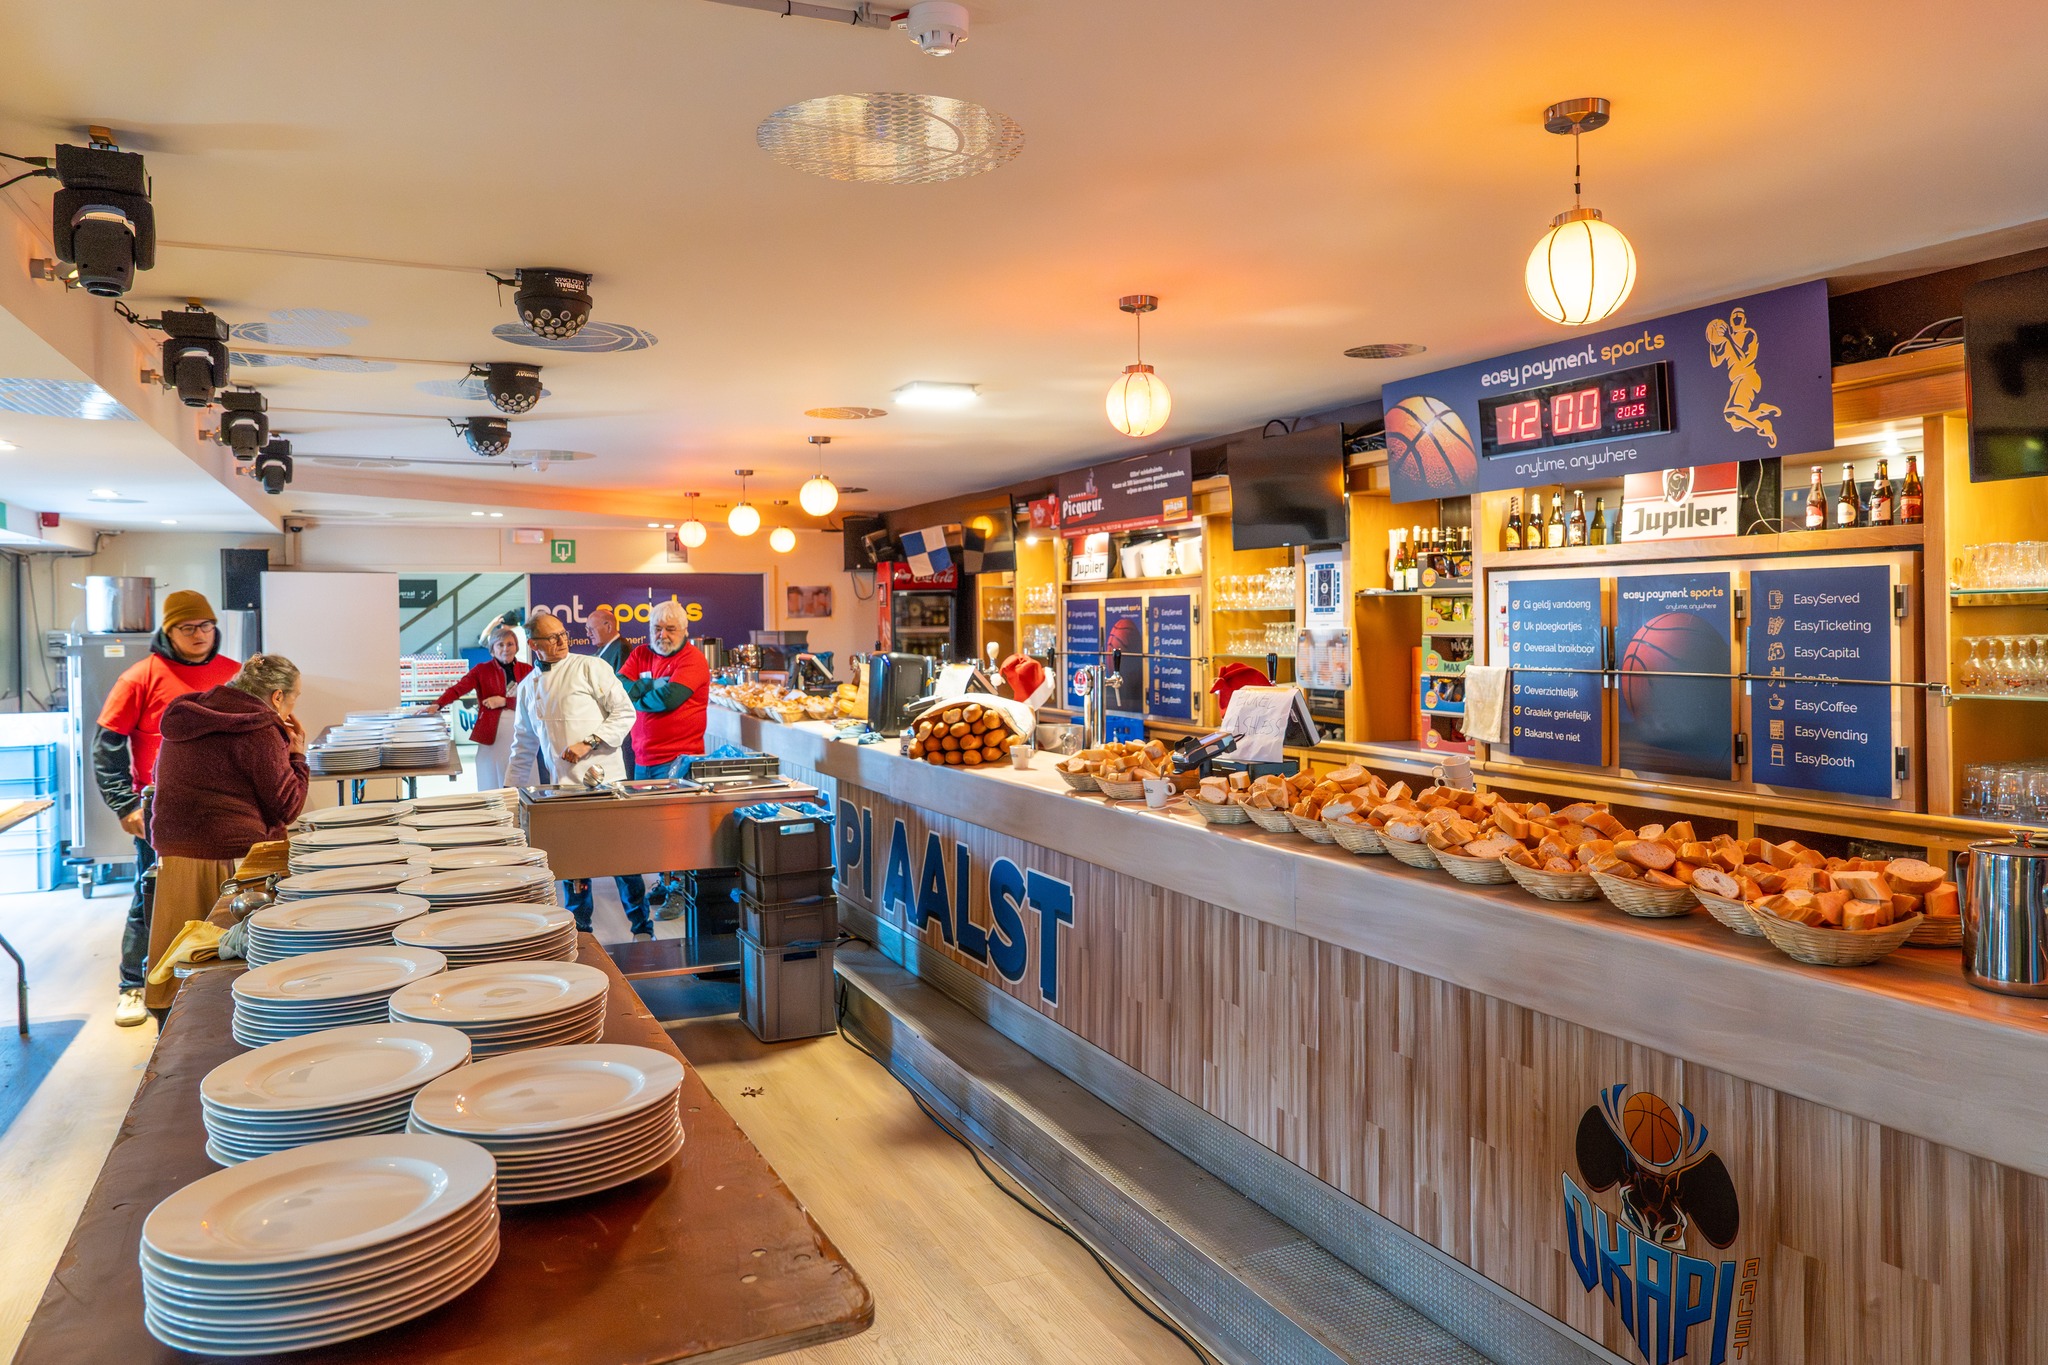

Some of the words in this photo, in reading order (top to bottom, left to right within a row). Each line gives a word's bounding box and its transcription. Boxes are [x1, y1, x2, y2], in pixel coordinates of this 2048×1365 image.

[1481, 367, 1518, 387] easy
[1522, 344, 1597, 384] payment
[1601, 331, 1666, 365] sports
[1612, 388, 1626, 401] 25
[1635, 384, 1647, 397] 12
[1511, 389, 1599, 440] 12:00
[1617, 403, 1645, 418] 2025
[1515, 456, 1567, 478] anytime,
[1570, 447, 1638, 470] anywhere
[1629, 502, 1727, 536] Jupiler
[1074, 561, 1104, 577] Jupiler
[1623, 591, 1645, 602] easy
[1646, 587, 1688, 601] payment
[1690, 586, 1724, 600] sports
[1793, 593, 1860, 606] EasyServed
[1523, 600, 1531, 609] Gi
[1532, 600, 1551, 610] geldj
[1552, 601, 1591, 611] vandoeng
[1689, 602, 1717, 611] anywhere
[1523, 622, 1534, 630] Uk
[1535, 623, 1582, 632] ploegkortjes
[1793, 620, 1871, 633] EasyTicketing
[1523, 643, 1557, 653] Oeveraal
[1557, 643, 1595, 654] broikboor
[1794, 646, 1860, 660] EasyCapital
[1443, 663, 1461, 672] MAX
[1523, 685, 1579, 698] Oeverzichtelijk
[1524, 707, 1553, 718] Graalek
[1553, 709, 1592, 721] geriefelijk
[1794, 700, 1858, 713] EasyCoffee
[1226, 716, 1282, 738] CASHLESS
[1524, 728, 1554, 739] Bakanst
[1554, 732, 1565, 741] ve
[1566, 732, 1580, 742] niet
[1794, 726, 1868, 744] EasyVending
[1795, 753, 1855, 768] EasyBooth
[882, 817, 1075, 1008] AALST
[1562, 1170, 1736, 1365] OKAPI
[1733, 1257, 1760, 1361] AALST
